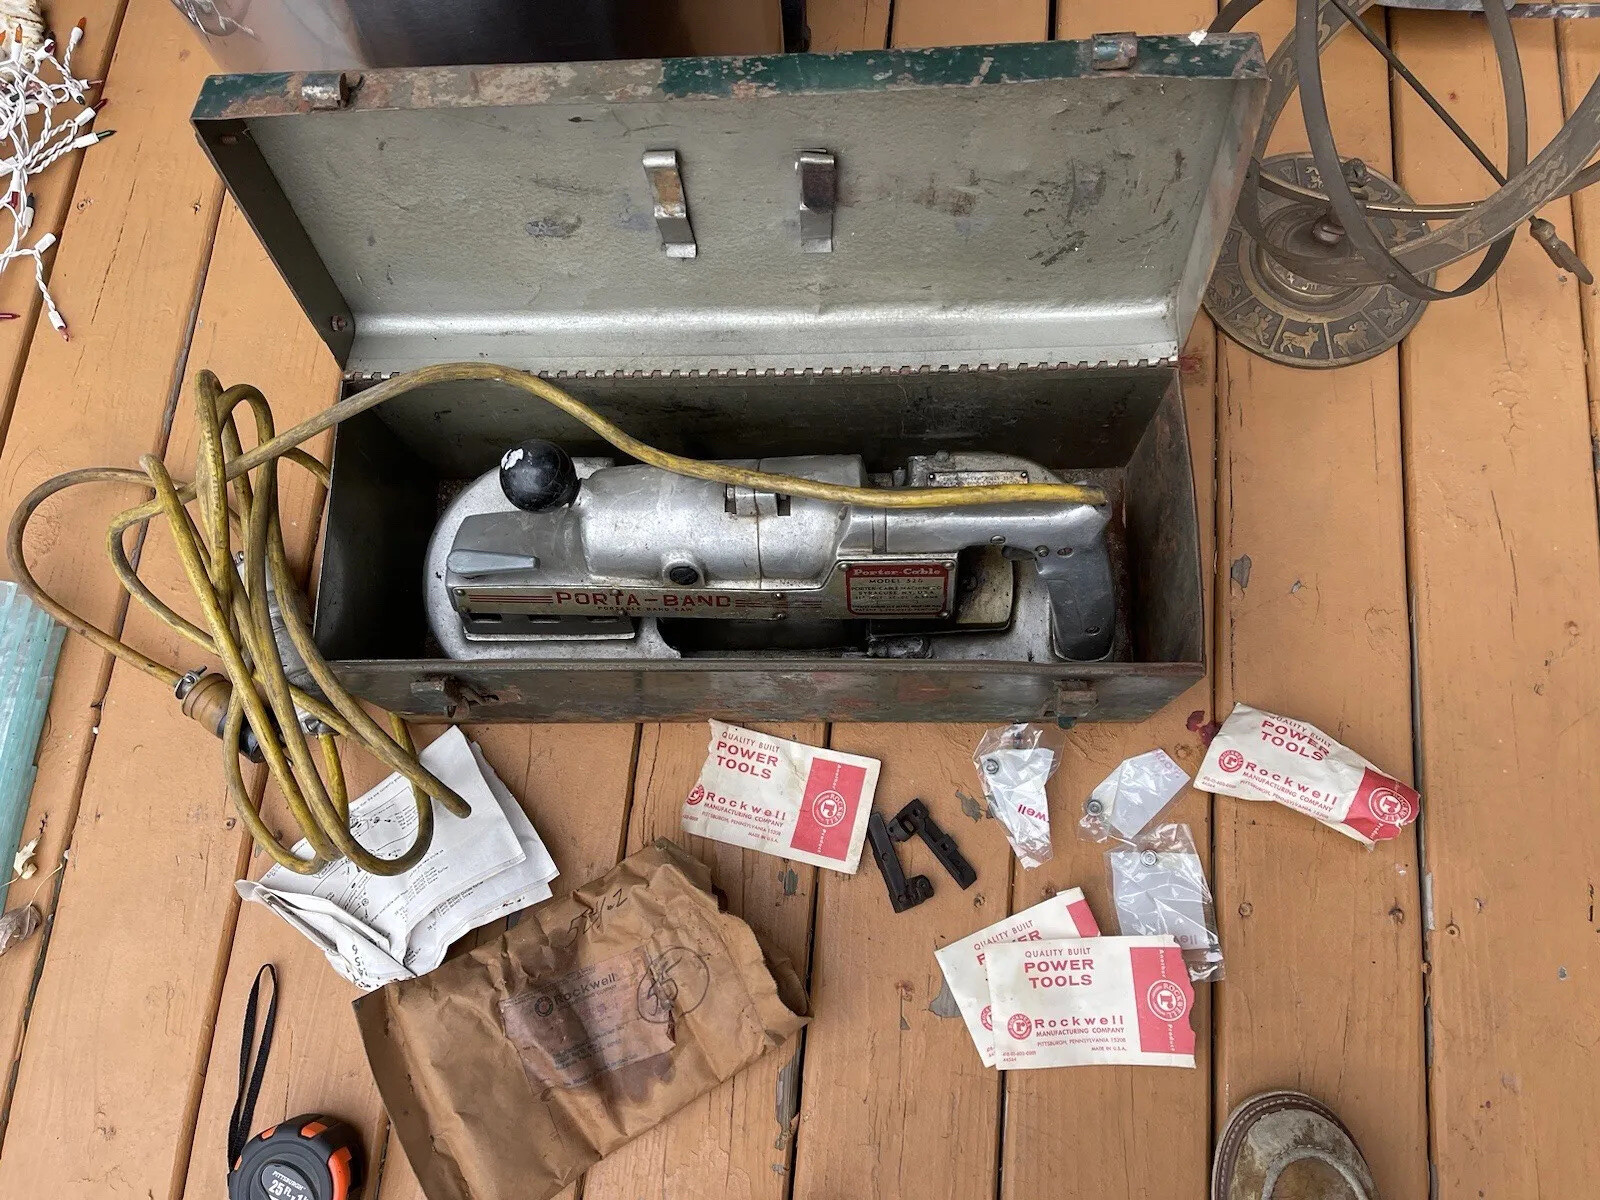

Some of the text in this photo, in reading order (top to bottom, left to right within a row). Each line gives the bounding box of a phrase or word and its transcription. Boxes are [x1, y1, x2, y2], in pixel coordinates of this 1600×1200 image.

[853, 568, 941, 576] Porter-Cable
[721, 731, 780, 753] QUALITY BUILT
[1261, 720, 1330, 757] POWER
[1261, 730, 1324, 761] TOOLS
[716, 740, 779, 768] POWER
[717, 755, 772, 780] TOOLS
[1242, 771, 1298, 799] MANUFACTURING
[1299, 795, 1334, 813] COMPANY
[1245, 761, 1338, 806] Rockwell
[703, 802, 753, 821] MANUFACTURING
[754, 815, 784, 828] COMPANY
[706, 791, 786, 821] Rockwell
[1011, 920, 1034, 935] BUILT
[977, 930, 1043, 966] PER
[1024, 947, 1091, 958] QUALITY BUILT
[1023, 958, 1095, 974] POWER
[1028, 974, 1093, 989] TOOLS
[1034, 1015, 1124, 1029] Rockwell
[1036, 1026, 1126, 1038] MANUFACTURING COMPANY
[268, 1179, 286, 1196] 25
